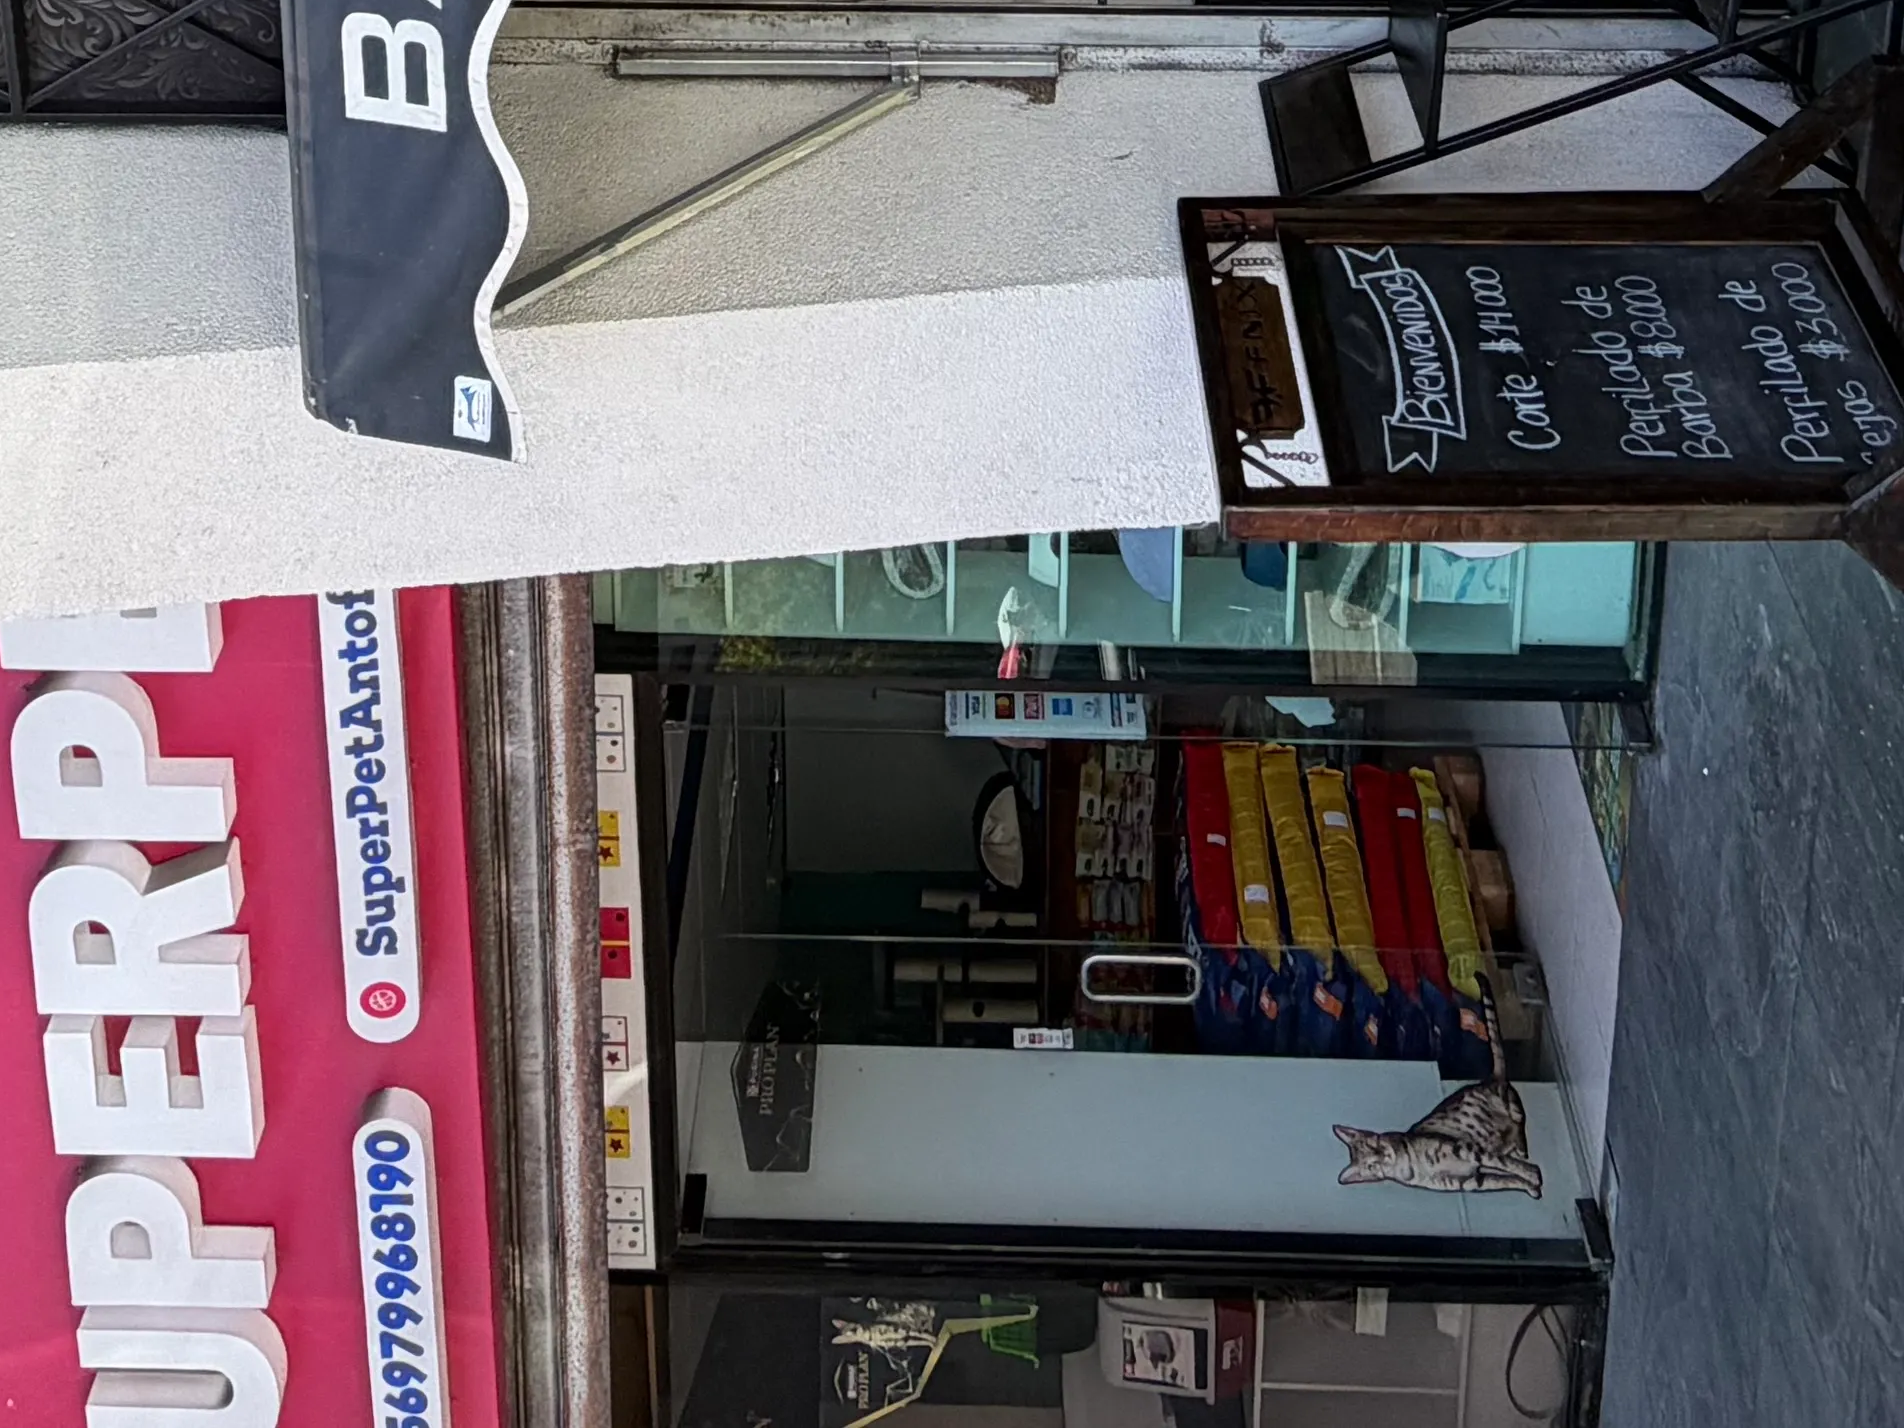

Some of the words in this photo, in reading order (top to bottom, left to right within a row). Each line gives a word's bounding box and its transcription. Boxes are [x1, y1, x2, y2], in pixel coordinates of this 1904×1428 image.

[1560, 285, 1613, 319] de
[1614, 275, 1685, 359] $8.000
[1717, 279, 1767, 313] de
[1496, 373, 1562, 450] Corte
[1662, 370, 1734, 459] Barba
[764, 1026, 780, 1074] PLAN
[759, 1078, 774, 1115] PRO
